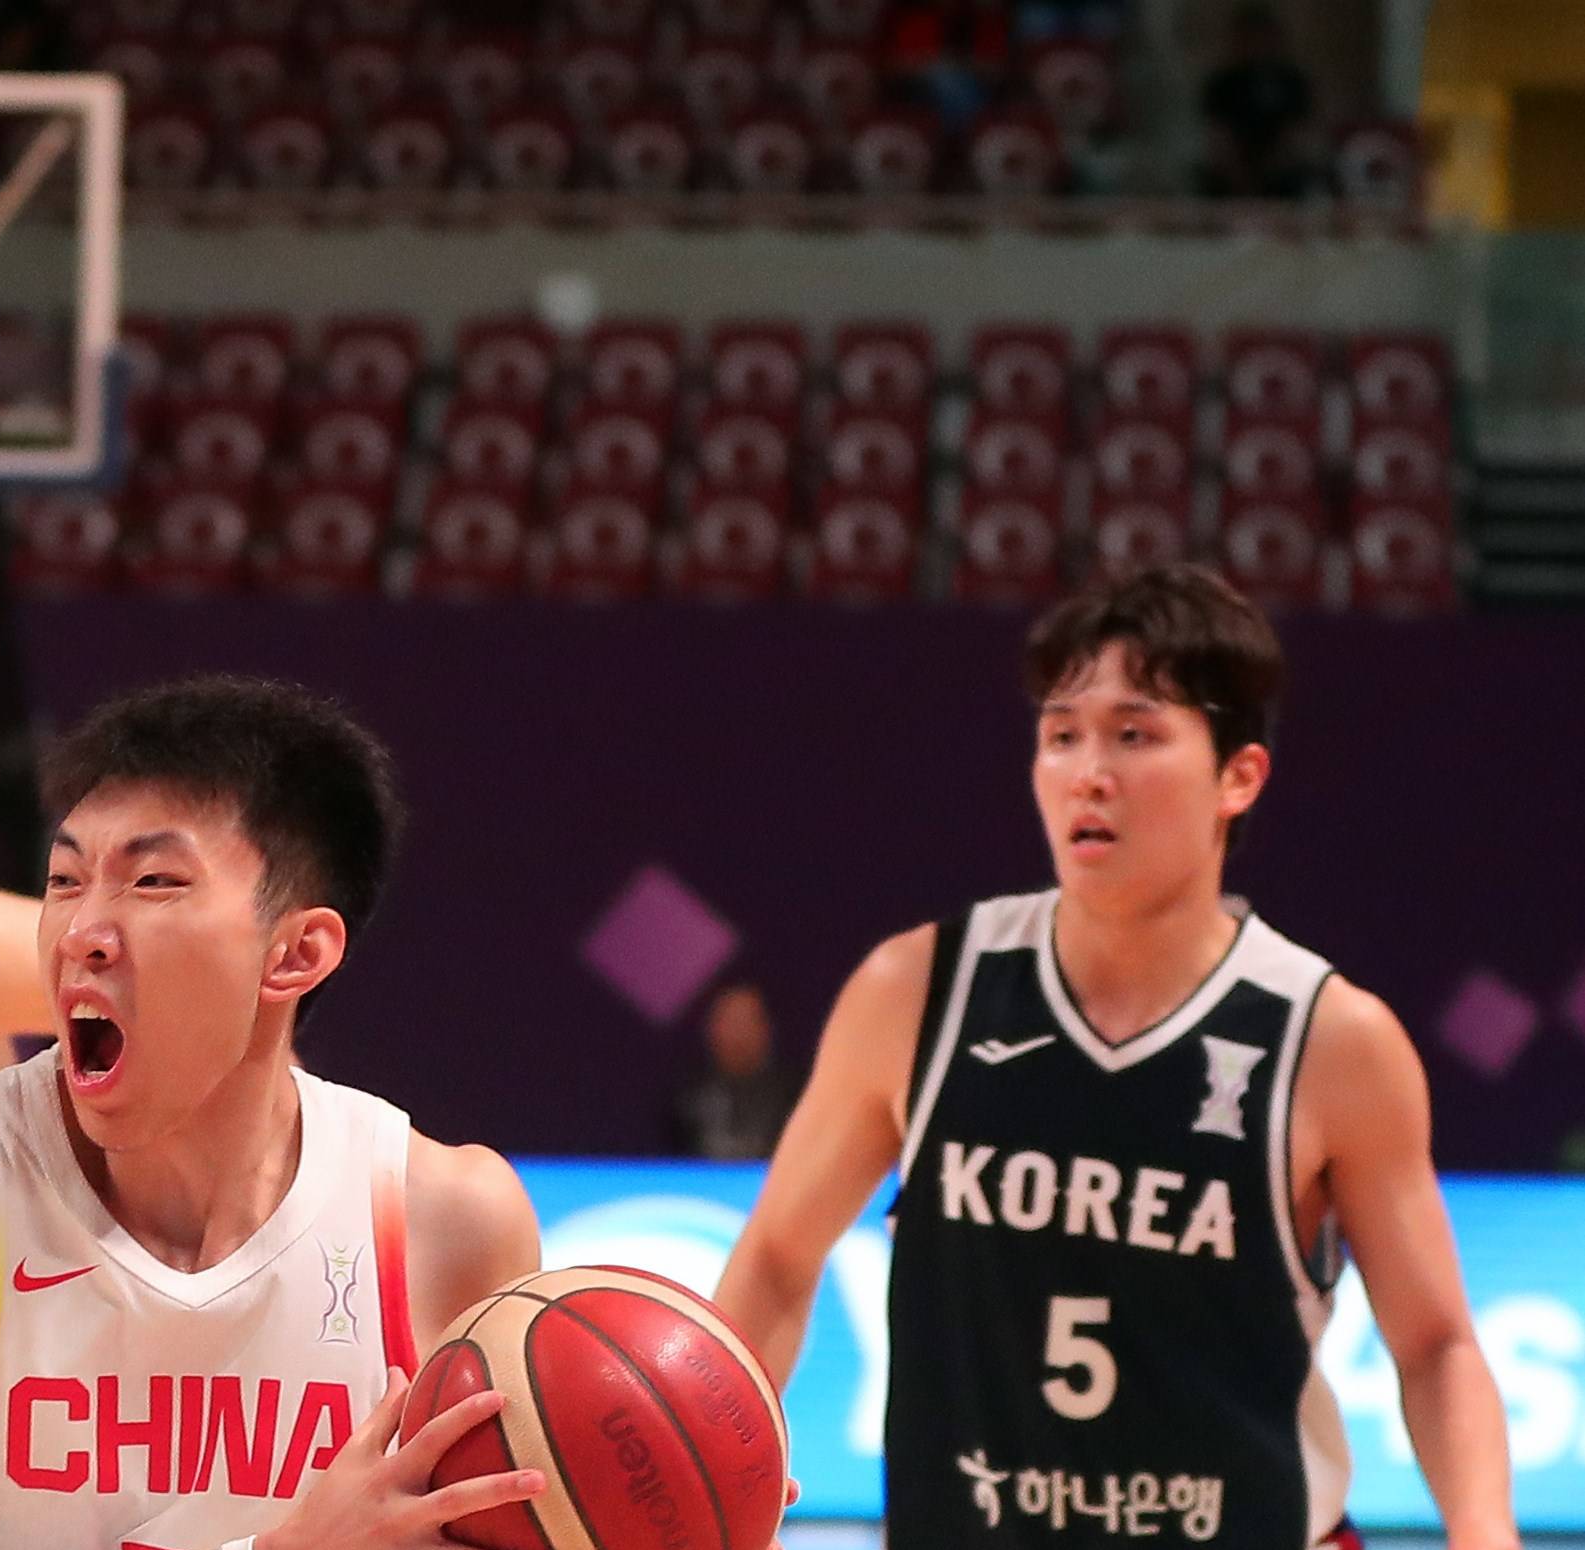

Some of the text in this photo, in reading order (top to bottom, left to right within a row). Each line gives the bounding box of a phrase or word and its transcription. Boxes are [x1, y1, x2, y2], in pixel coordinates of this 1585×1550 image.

[940, 1141, 1238, 1263] KOREA
[1040, 1293, 1120, 1422] 5
[6, 1374, 354, 1500] CHINA
[1016, 1467, 1224, 1543] 하나은행
